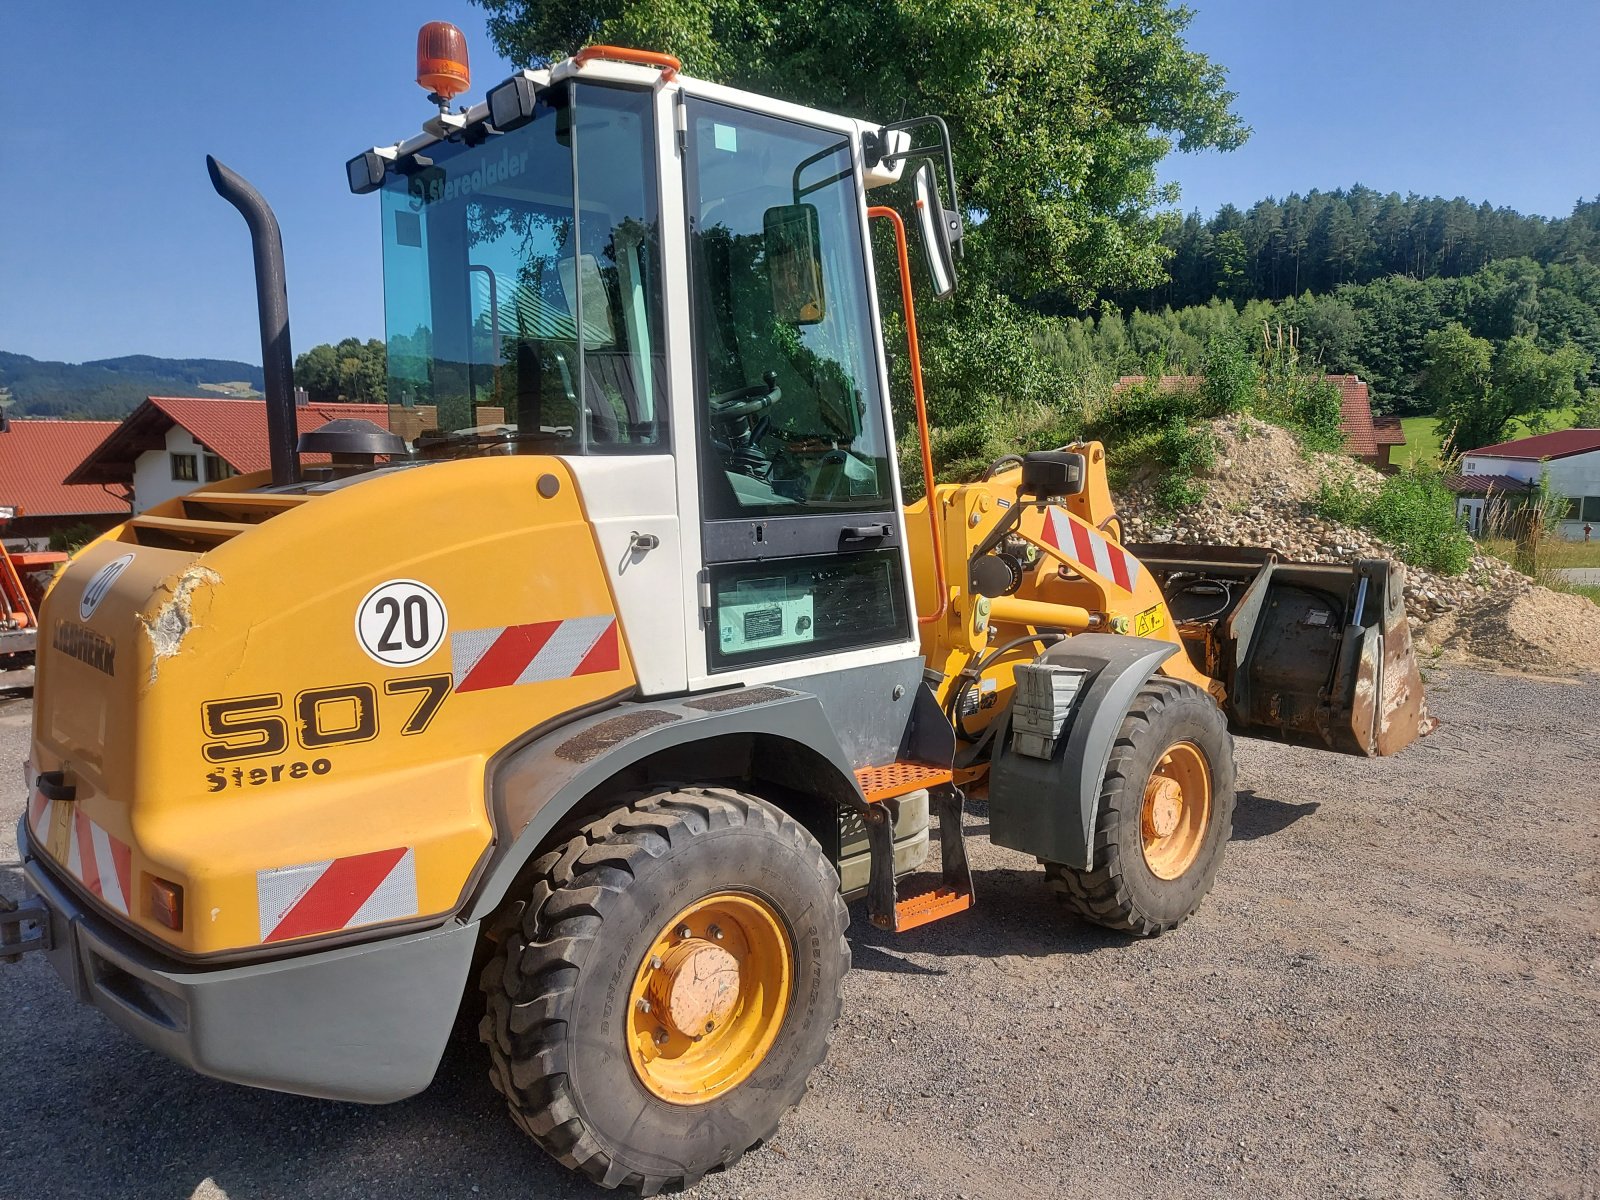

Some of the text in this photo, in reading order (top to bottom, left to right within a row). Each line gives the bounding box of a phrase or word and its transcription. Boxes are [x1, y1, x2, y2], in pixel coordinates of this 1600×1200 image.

[430, 150, 529, 202] stereolader
[84, 561, 125, 607] 20
[375, 594, 429, 652] 20
[201, 671, 453, 763] 507
[206, 757, 332, 793] Stereo
